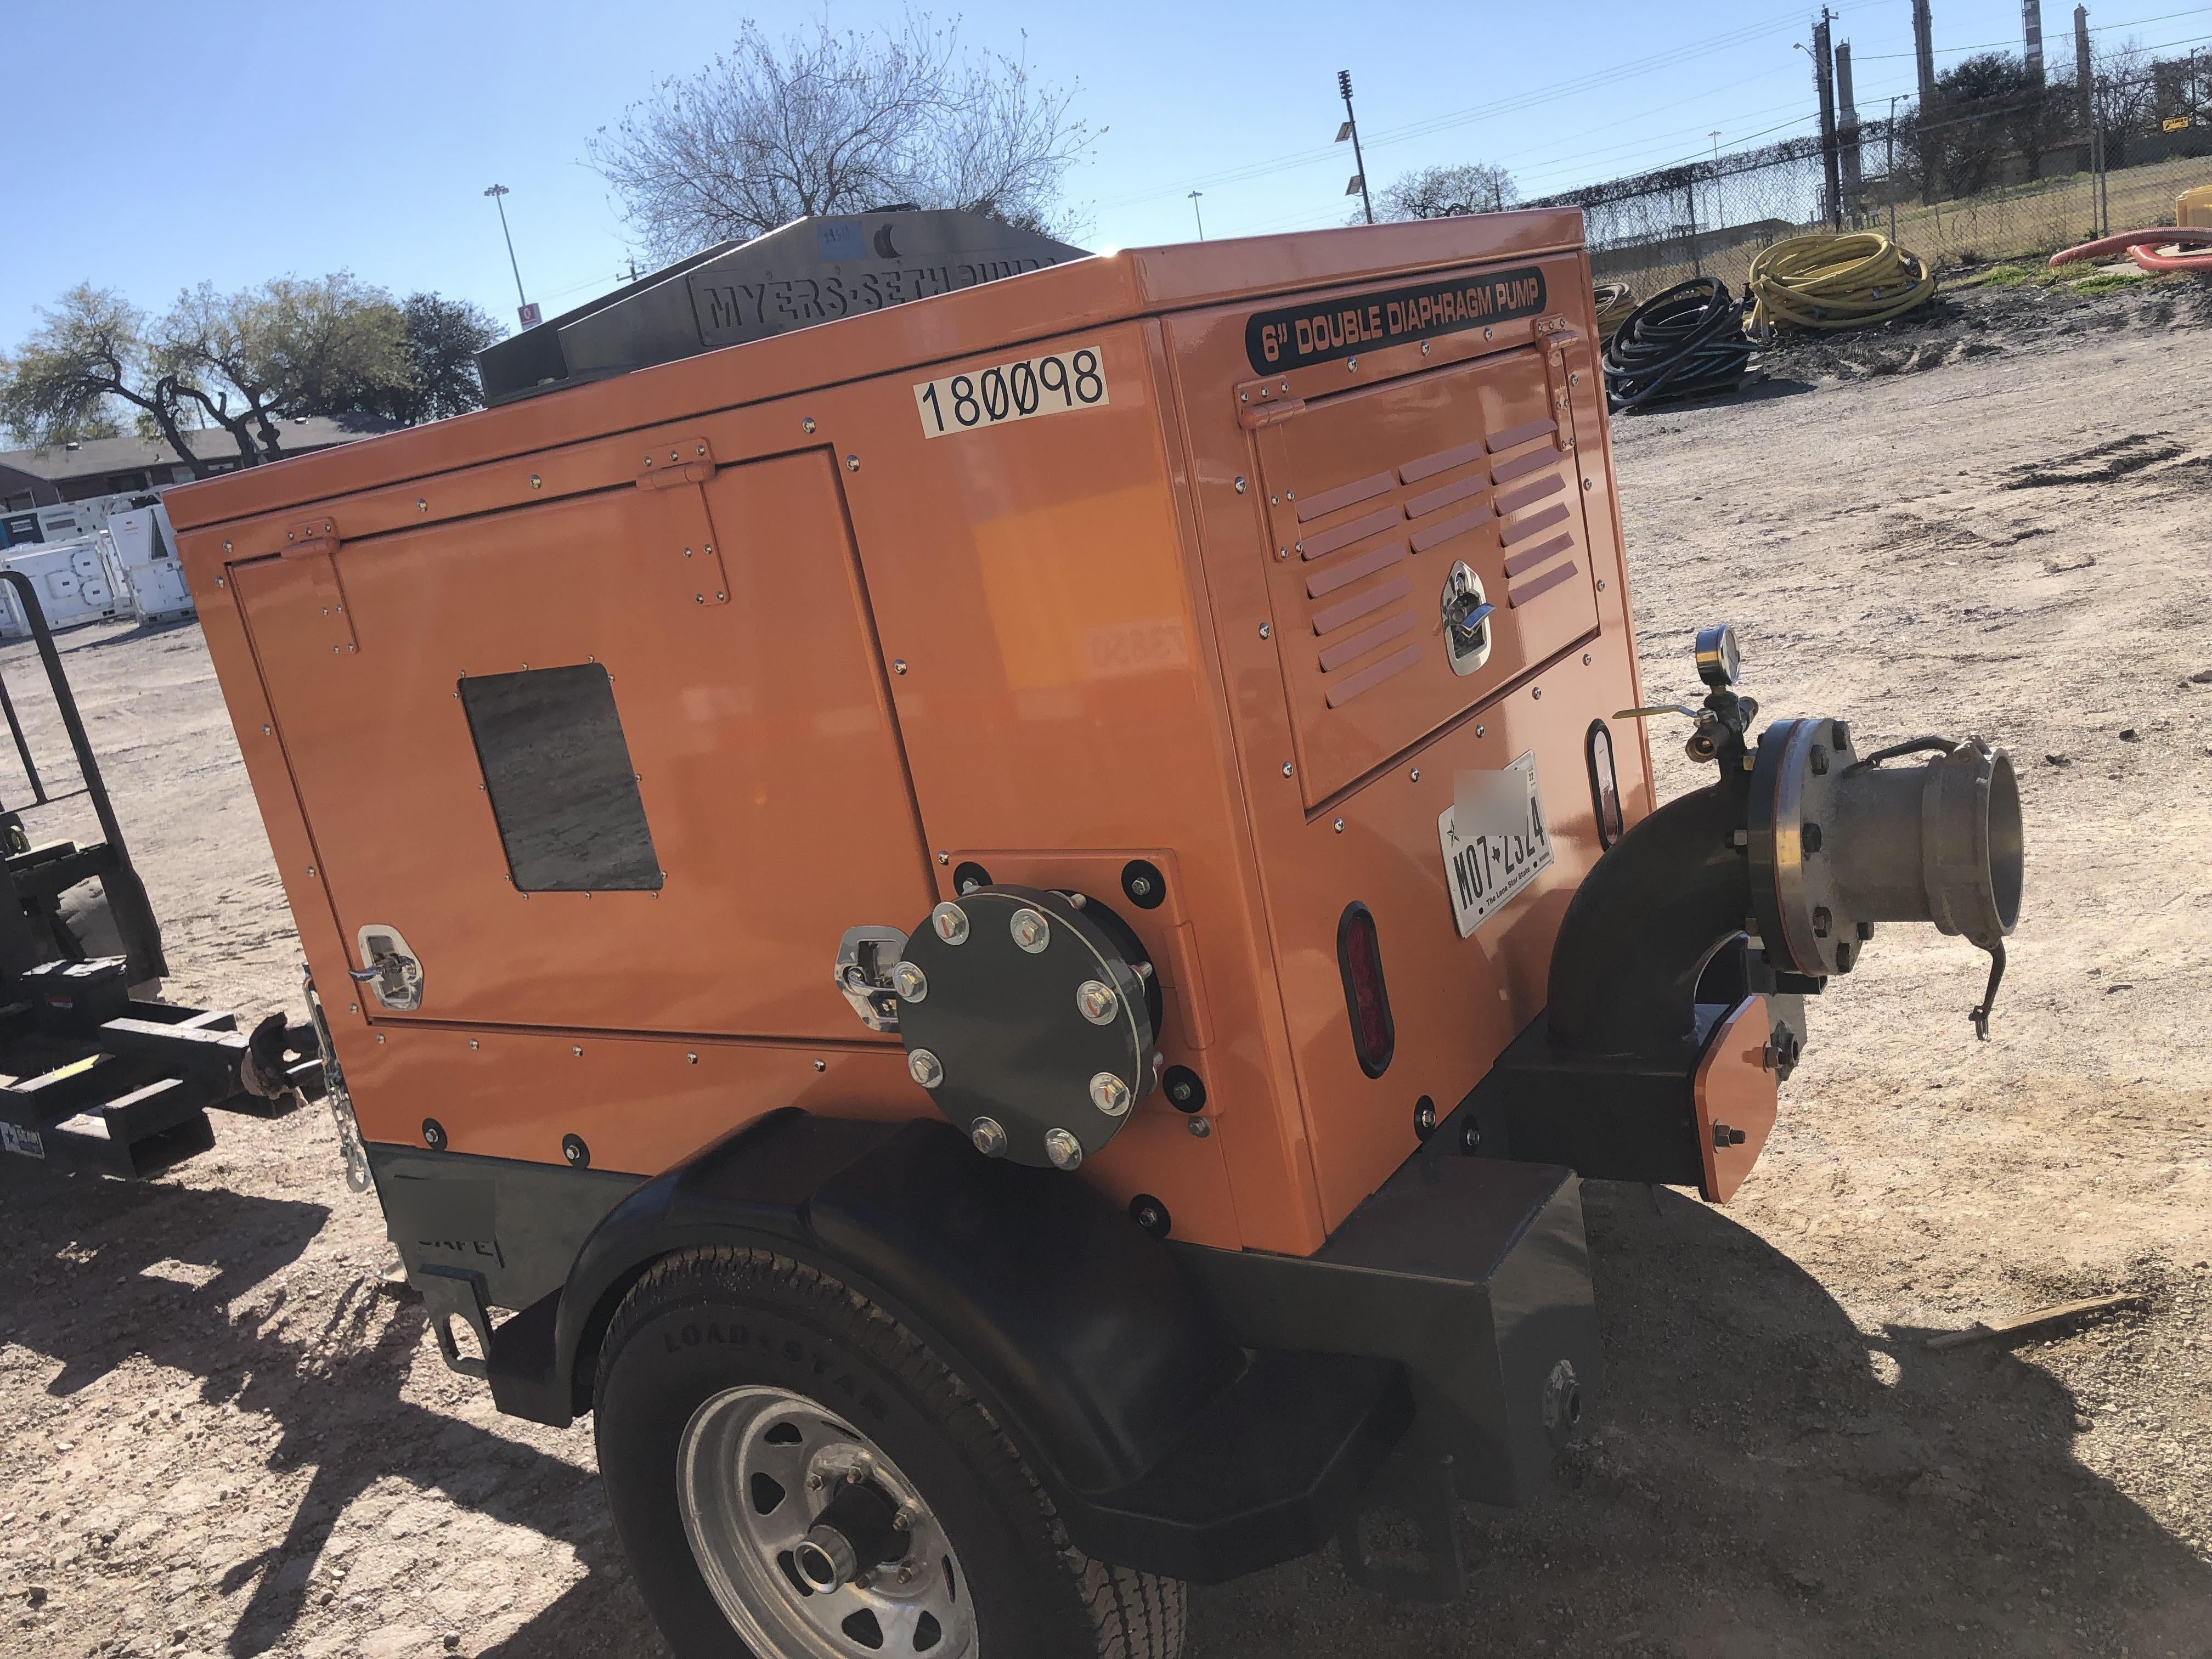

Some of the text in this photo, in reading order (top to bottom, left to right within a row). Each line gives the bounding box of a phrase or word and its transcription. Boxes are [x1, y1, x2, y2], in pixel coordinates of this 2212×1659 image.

[1296, 305, 1383, 354] DOUBLE
[1387, 285, 1493, 335] DIAPHRAGM
[1497, 276, 1539, 311] PUMP
[923, 349, 1103, 432] 180098
[1528, 772, 1534, 782] 22
[1453, 836, 1492, 910] M07
[1486, 866, 1531, 906] The Lone Star State
